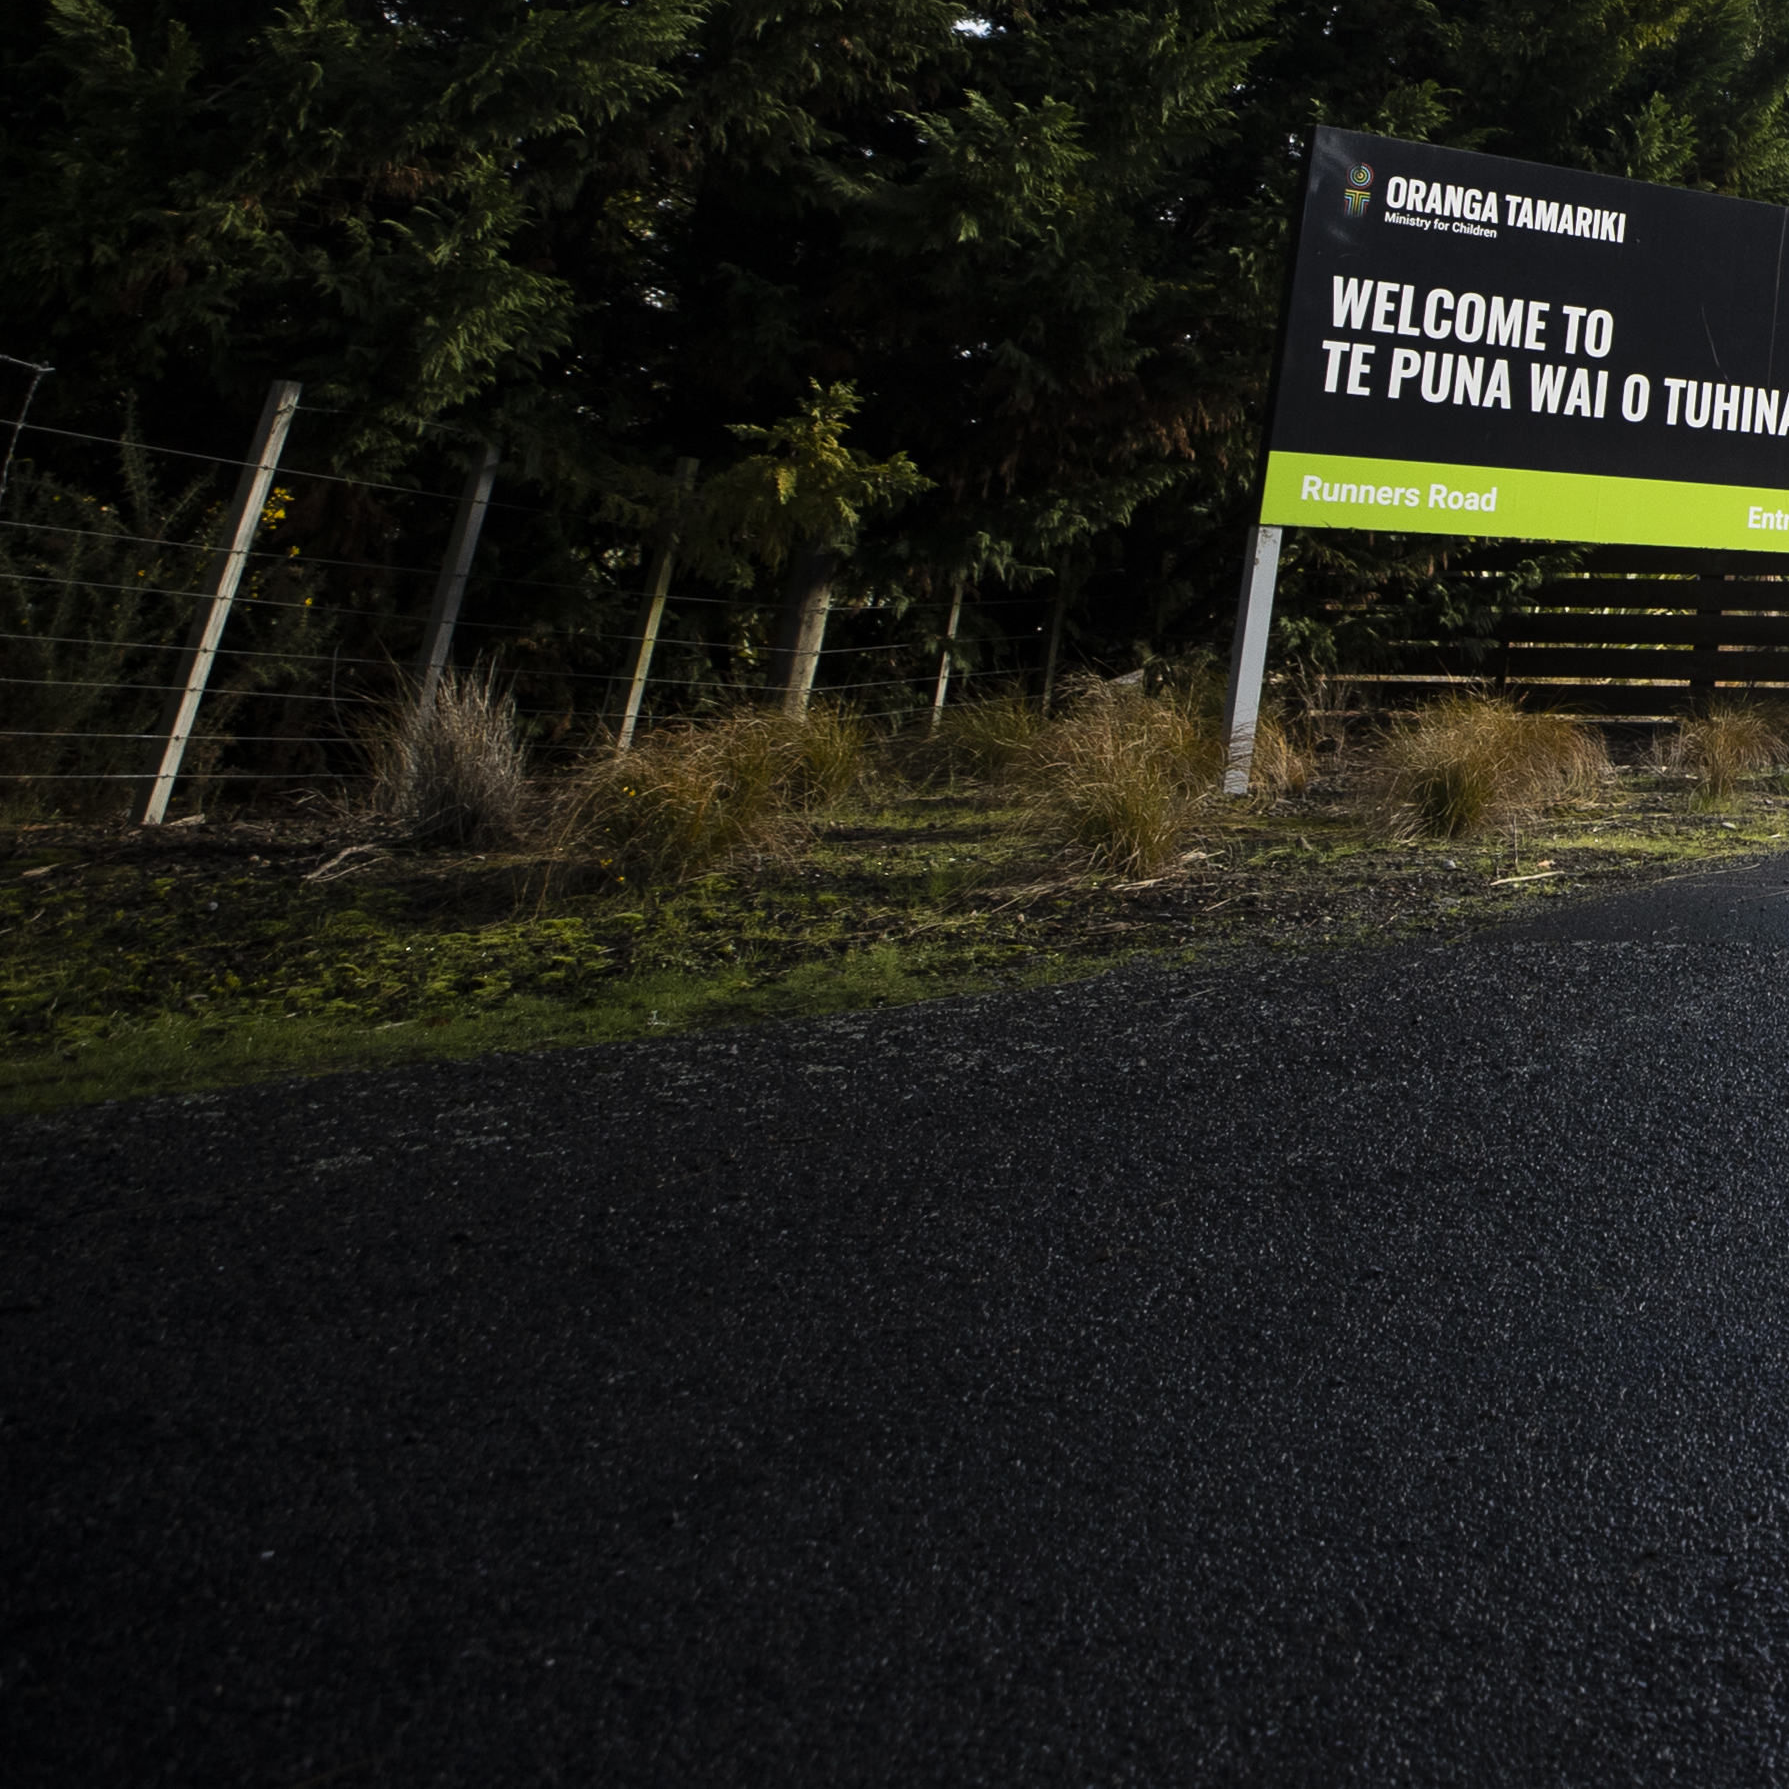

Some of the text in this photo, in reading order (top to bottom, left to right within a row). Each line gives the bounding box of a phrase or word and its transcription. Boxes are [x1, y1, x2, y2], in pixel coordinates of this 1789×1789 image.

[1384, 211, 1497, 239] Ministry for Children
[1386, 176, 1627, 243] ORANGA TAMARIKI
[1332, 275, 1614, 359] WELCOME TO
[1322, 340, 1376, 397] TE
[1388, 348, 1511, 410] PUNA
[1530, 363, 1609, 419] WAI
[1622, 374, 1651, 423] O
[1300, 475, 1498, 513] Runners Road
